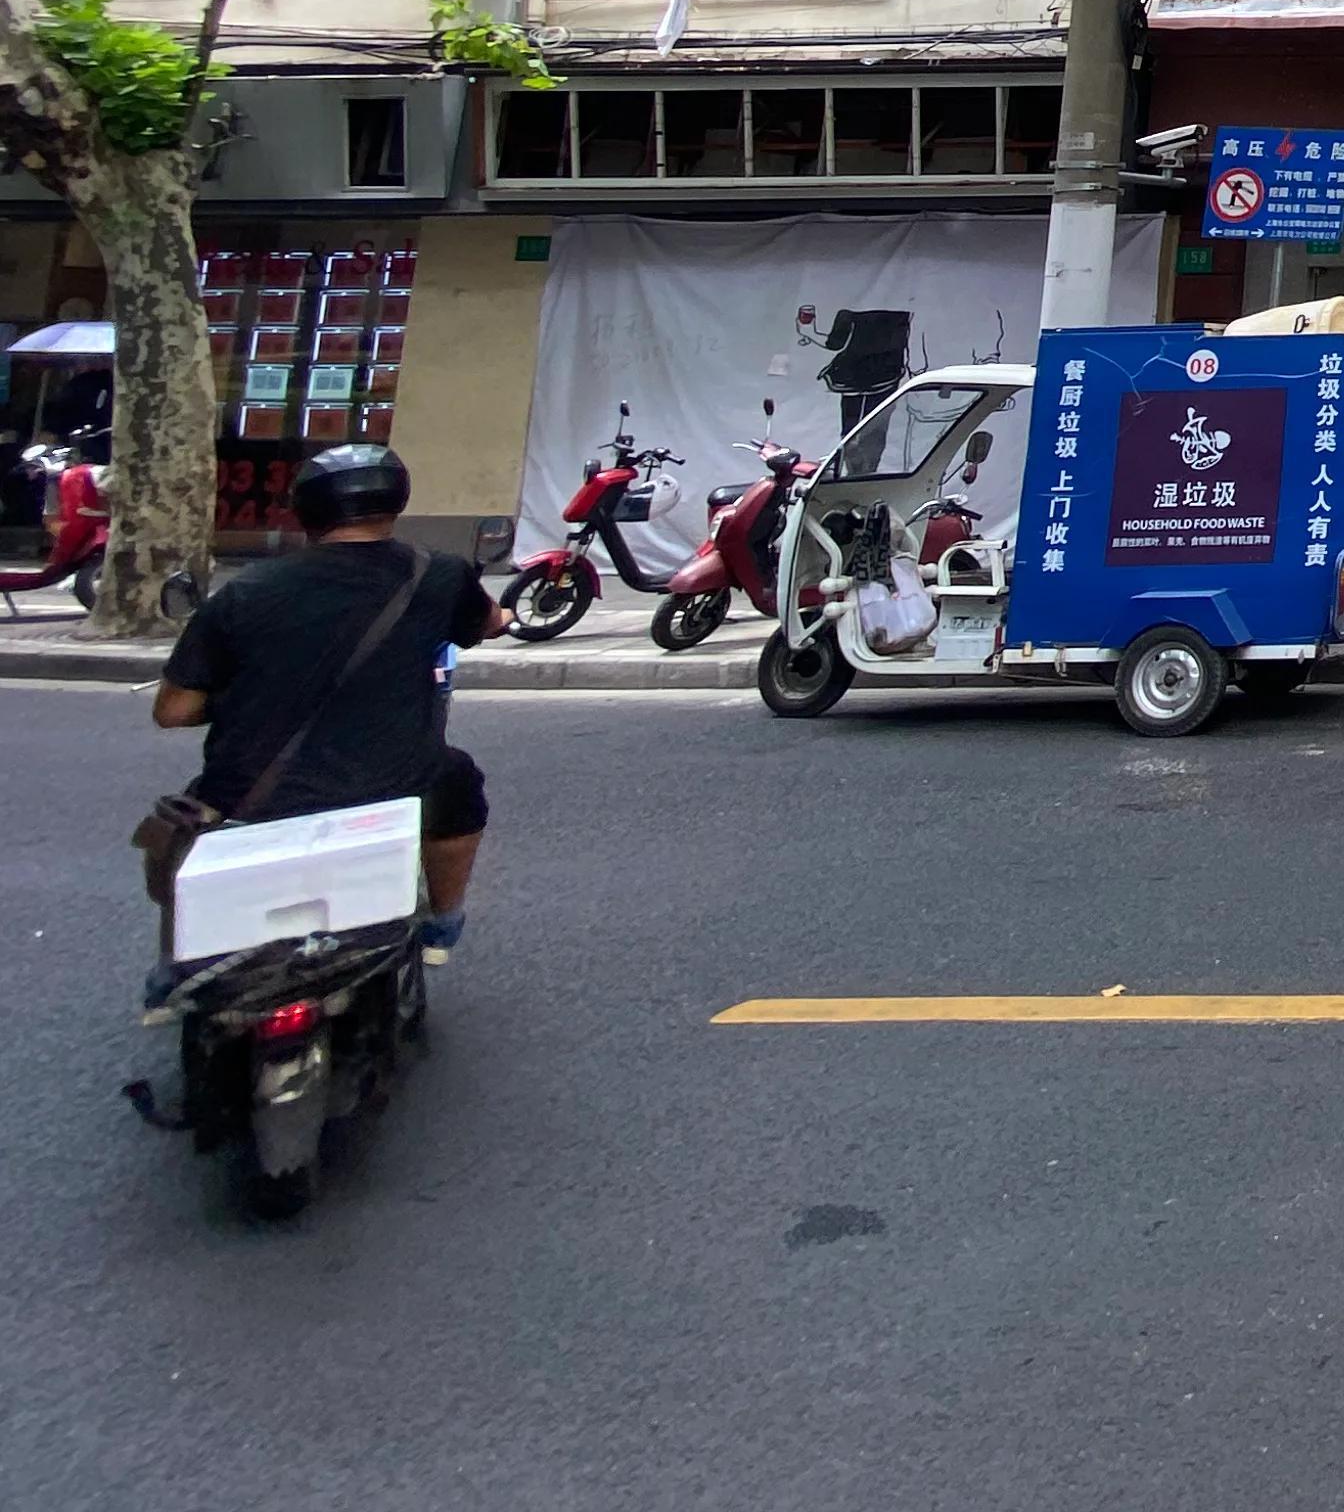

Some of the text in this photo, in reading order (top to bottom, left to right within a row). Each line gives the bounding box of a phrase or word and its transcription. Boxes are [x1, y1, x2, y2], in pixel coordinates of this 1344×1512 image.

[1222, 139, 1265, 157] 高压
[1190, 358, 1216, 375] 08
[1042, 360, 1086, 572] 餐厨垃圾 上门收集
[1304, 353, 1343, 566] 垃圾分类 人人有责
[1153, 481, 1236, 508] 湿垃圾
[1122, 517, 1265, 530] HOUSEHOLD FOOD WASTE
